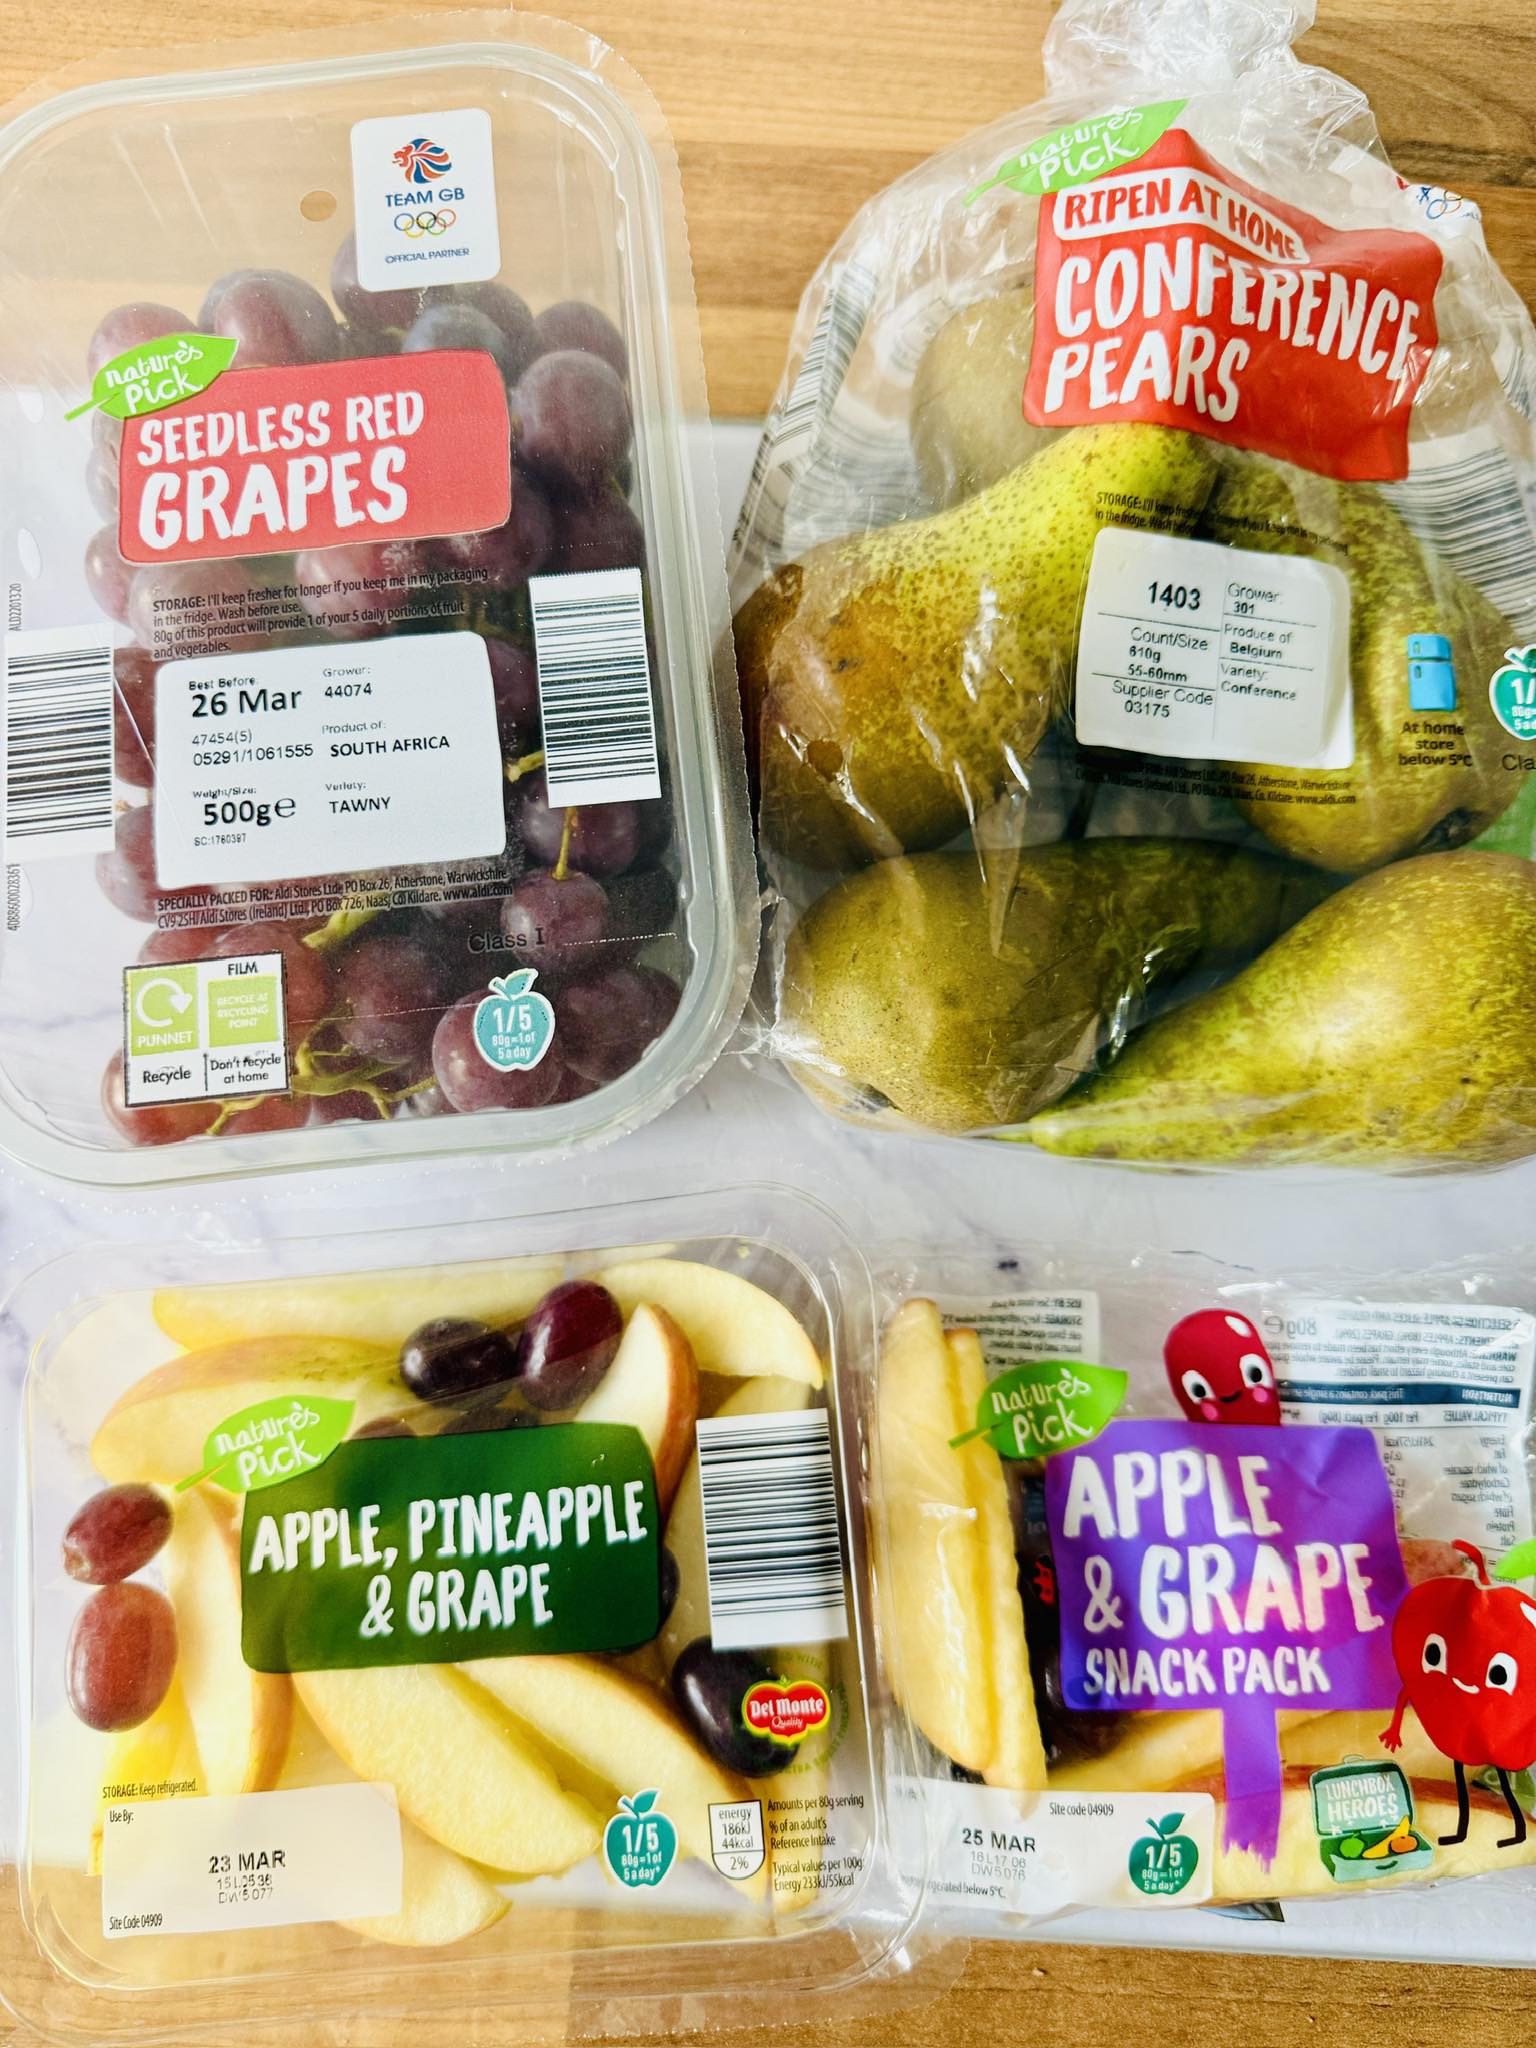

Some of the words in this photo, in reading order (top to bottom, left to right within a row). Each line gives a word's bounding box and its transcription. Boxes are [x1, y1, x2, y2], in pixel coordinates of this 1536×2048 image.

[385, 190, 433, 208] TEAM
[438, 187, 465, 202] GB
[1063, 177, 1171, 231] RIPEN
[1178, 178, 1227, 217] AT
[1228, 204, 1298, 261] HOME
[385, 252, 428, 264] OFFICIAL
[428, 247, 470, 259] PARTNER
[1055, 236, 1421, 383] CONFERENCE
[1043, 325, 1250, 424] PEARS
[136, 402, 331, 467] SEEDLESS
[346, 390, 425, 442] RED
[138, 446, 408, 550] GRAPES
[1096, 491, 1142, 510] STORAGE:
[153, 596, 206, 612] STORAGE:
[222, 591, 244, 607] keep
[247, 587, 282, 604] fresher
[284, 585, 299, 599] for
[300, 581, 333, 601] longer
[334, 579, 342, 593] if
[342, 581, 361, 596] you
[362, 577, 387, 592] keep
[389, 577, 406, 588] me
[407, 573, 418, 586] in
[418, 573, 436, 588] my
[437, 568, 488, 585] packaging
[1148, 581, 1201, 611] 1403
[153, 615, 163, 628] in
[165, 613, 182, 626] the
[184, 610, 216, 626] fridge.
[217, 606, 246, 620] Wash
[247, 603, 281, 617] before
[281, 602, 303, 614] use.
[1233, 600, 1255, 615] 301
[153, 631, 173, 646] 80g
[174, 628, 186, 641] of
[186, 626, 206, 640] this
[207, 621, 246, 641] product
[247, 619, 267, 633] will
[267, 616, 306, 634] provide
[315, 612, 327, 626] of
[327, 612, 351, 628] your
[351, 610, 359, 622] 5
[361, 608, 387, 625] daily
[388, 604, 430, 623] portions
[430, 602, 442, 615] of
[442, 600, 465, 614] fruit
[1223, 623, 1275, 642] Produce
[1130, 626, 1208, 652] Count/Size
[153, 645, 173, 659] and
[173, 641, 232, 659] vegetables.
[1230, 641, 1282, 659] Belgium
[1127, 663, 1187, 684] 55-60mm
[189, 680, 214, 692] Best
[324, 682, 373, 698] 44074
[1112, 679, 1170, 702] Supplier
[1173, 688, 1213, 706] Code
[1221, 680, 1296, 702] Conference
[192, 692, 228, 718] 26
[239, 689, 302, 714] Mar
[1124, 699, 1170, 719] 03175
[192, 729, 253, 748] 47454(5)
[322, 722, 368, 736] Product
[1400, 721, 1419, 736] At
[1423, 721, 1465, 736] home
[330, 740, 387, 758] SOUTH
[392, 735, 451, 753] AFRICA
[1415, 738, 1455, 751] store
[1398, 752, 1446, 767] below
[328, 796, 391, 814] TAWNY
[157, 893, 209, 912] SPECIALLY
[209, 889, 248, 908] PACKED
[249, 887, 274, 903] FOR:
[274, 885, 292, 900] Aldi
[293, 883, 322, 899] Stores
[344, 880, 359, 895] PO
[359, 878, 377, 893] Box
[378, 876, 393, 892] 26,
[394, 872, 446, 890] Atherstone,
[446, 867, 509, 886] Warwickshire
[468, 931, 528, 953] Class
[227, 962, 259, 976] FILM
[492, 1003, 533, 1034] 1/5
[136, 1030, 193, 1048] PUNNET
[210, 1056, 240, 1072] Don't
[242, 1053, 281, 1070] recycle
[143, 1065, 191, 1086] Recycle
[223, 1073, 236, 1085] at
[238, 1070, 269, 1084] home
[1062, 1448, 1284, 1540] APPLE
[247, 1503, 399, 1576] APPLE,
[408, 1479, 648, 1563] PINEAPPLE
[359, 1573, 394, 1639] &
[406, 1562, 555, 1636] GRAPE
[1083, 1555, 1125, 1635] &
[1139, 1541, 1385, 1641] GRAPE
[1082, 1646, 1221, 1699] SNACK
[1222, 1645, 1332, 1698] PACK
[750, 1698, 775, 1720] Del
[775, 1696, 825, 1718] Monte
[771, 1715, 804, 1731] Quality
[102, 1783, 138, 1799] STORAGE:
[139, 1782, 155, 1799] Keep
[156, 1777, 199, 1797] refrigerated.
[1325, 1774, 1395, 1801] LUNCHBOX
[767, 1798, 803, 1813] Amounts
[805, 1798, 818, 1812] per
[818, 1796, 835, 1811] 80g
[835, 1792, 864, 1810] serving
[1049, 1801, 1066, 1816] Site
[1066, 1802, 1087, 1816] code
[1087, 1802, 1115, 1818] 04909
[1327, 1793, 1399, 1823] HEROES
[109, 1810, 122, 1823] Use
[122, 1808, 134, 1825] By:
[719, 1808, 752, 1822] energy
[769, 1820, 779, 1834] %
[779, 1818, 790, 1832] of
[790, 1820, 800, 1832] an
[801, 1816, 827, 1831] adult's
[622, 1822, 660, 1853] 1/5
[722, 1821, 752, 1837] 186kJ
[721, 1835, 754, 1851] 44kcal
[770, 1835, 809, 1851] Reference
[809, 1832, 836, 1848] Intake
[961, 1827, 984, 1848] 25
[990, 1830, 1036, 1853] MAR
[208, 1855, 231, 1874] 23
[238, 1849, 286, 1872] MAR
[729, 1855, 750, 1871] 2%
[1145, 1842, 1182, 1870] 1/5
[772, 1858, 801, 1877] Typical
[802, 1857, 827, 1872] values
[827, 1857, 841, 1874] per
[1173, 1867, 1184, 1879] of
[774, 1877, 801, 1894] Energy
[803, 1872, 855, 1891] 233kJ/55kcal
[964, 1881, 990, 1897] below
[1143, 1880, 1150, 1891] 5
[1151, 1882, 1158, 1891] a
[109, 1915, 123, 1931] Site
[123, 1913, 141, 1930] Code
[141, 1911, 163, 1929] 04909
